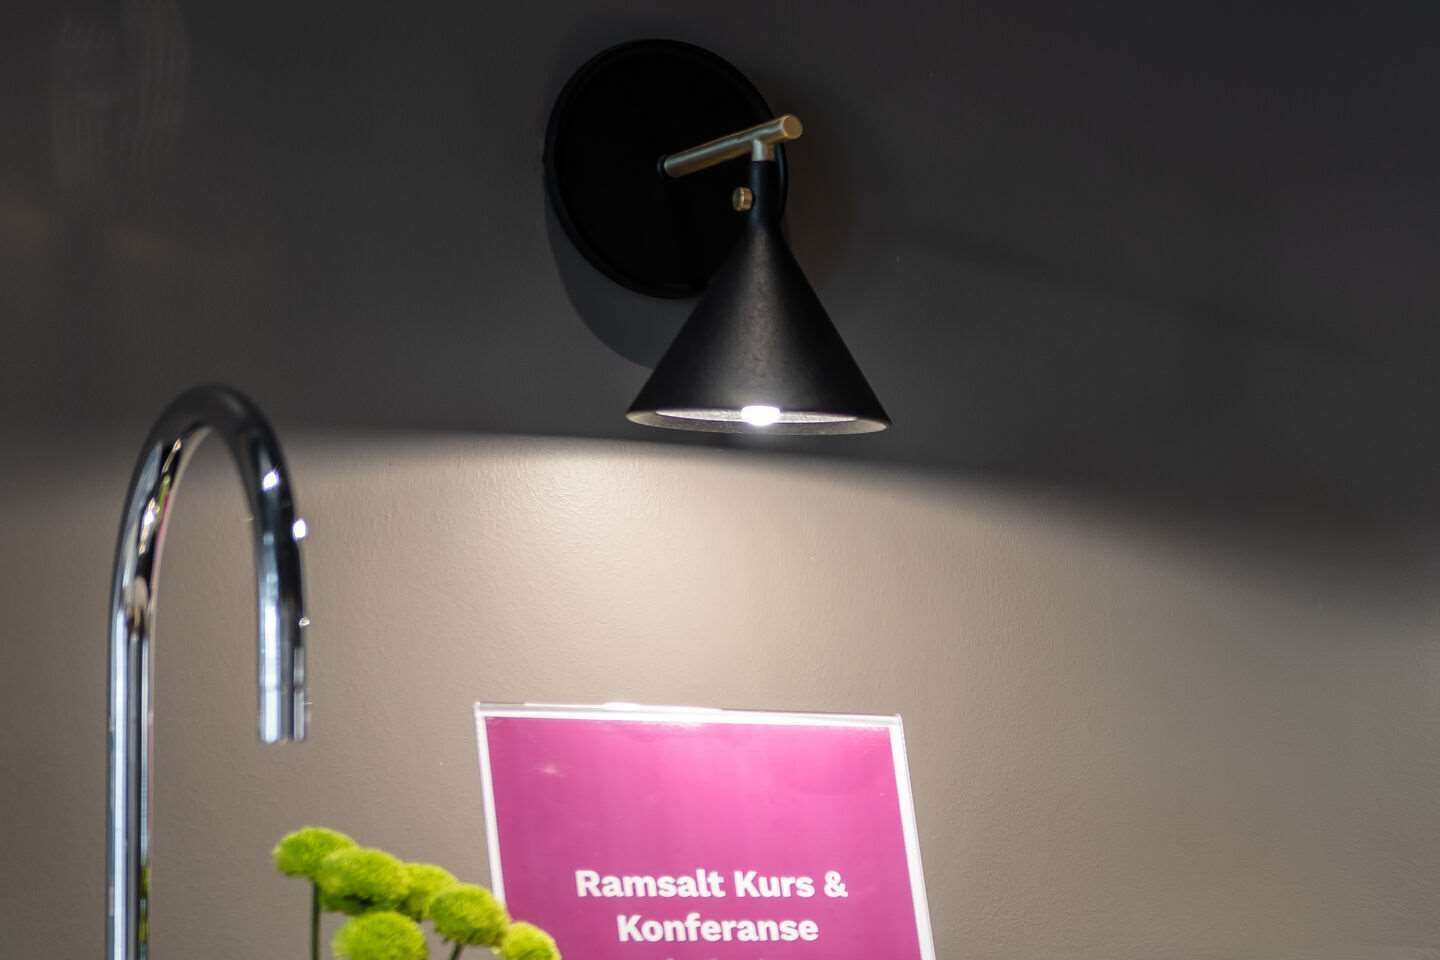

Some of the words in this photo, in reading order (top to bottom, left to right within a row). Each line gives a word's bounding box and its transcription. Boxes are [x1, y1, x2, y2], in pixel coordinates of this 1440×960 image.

[575, 869, 726, 898] Ramsalt
[733, 870, 816, 898] Kurs
[824, 871, 849, 898] &
[616, 913, 820, 942] Konferanse
